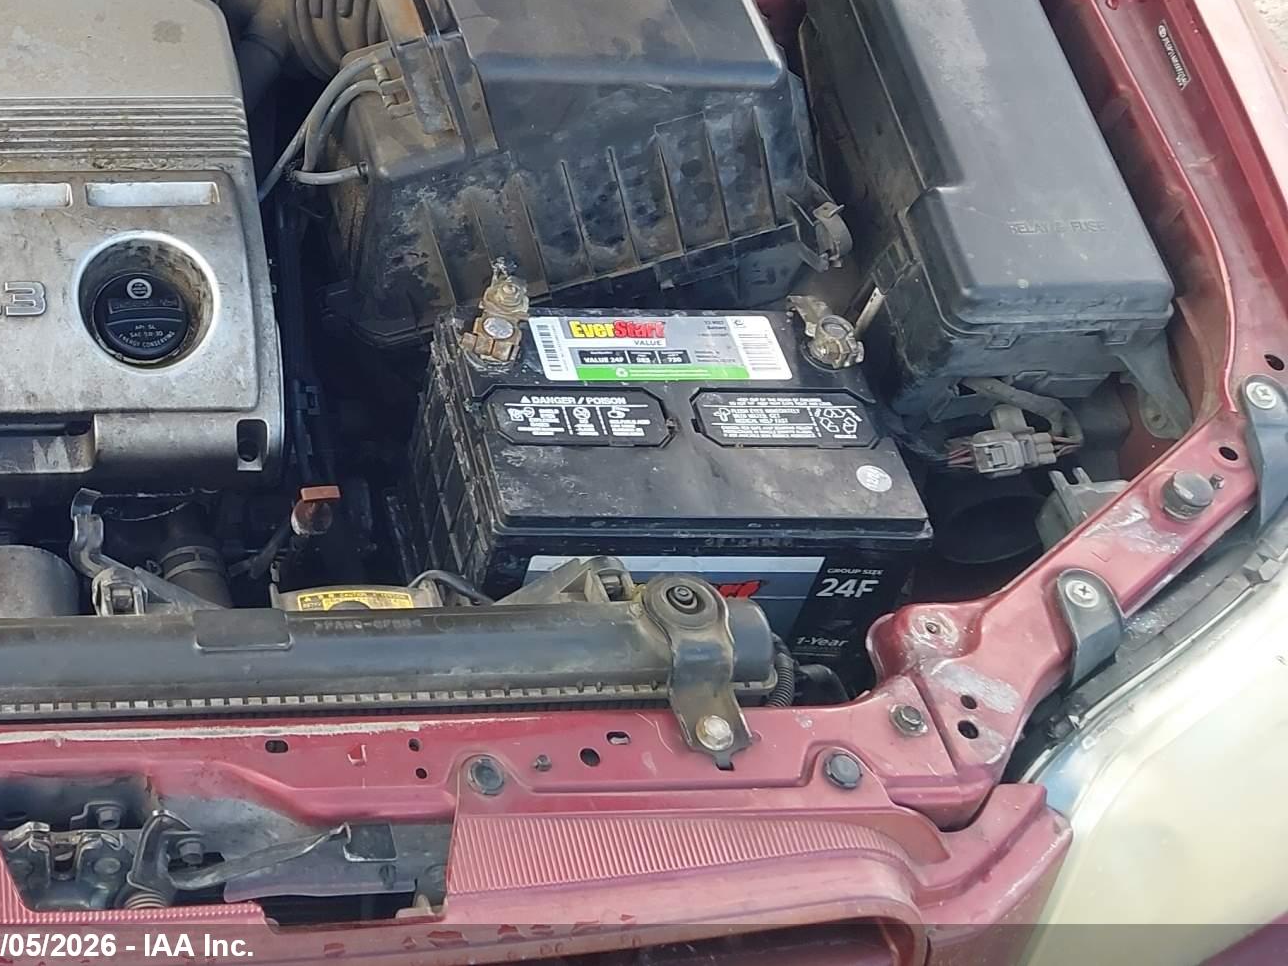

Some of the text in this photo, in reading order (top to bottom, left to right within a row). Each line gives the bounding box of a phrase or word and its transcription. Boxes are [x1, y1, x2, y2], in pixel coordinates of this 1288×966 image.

[569, 320, 665, 339] EverStart
[531, 396, 576, 405] DANGER
[585, 396, 627, 405] POISON
[862, 568, 884, 576] SIZE
[816, 578, 879, 598] 24F
[796, 636, 849, 647] 1-Year
